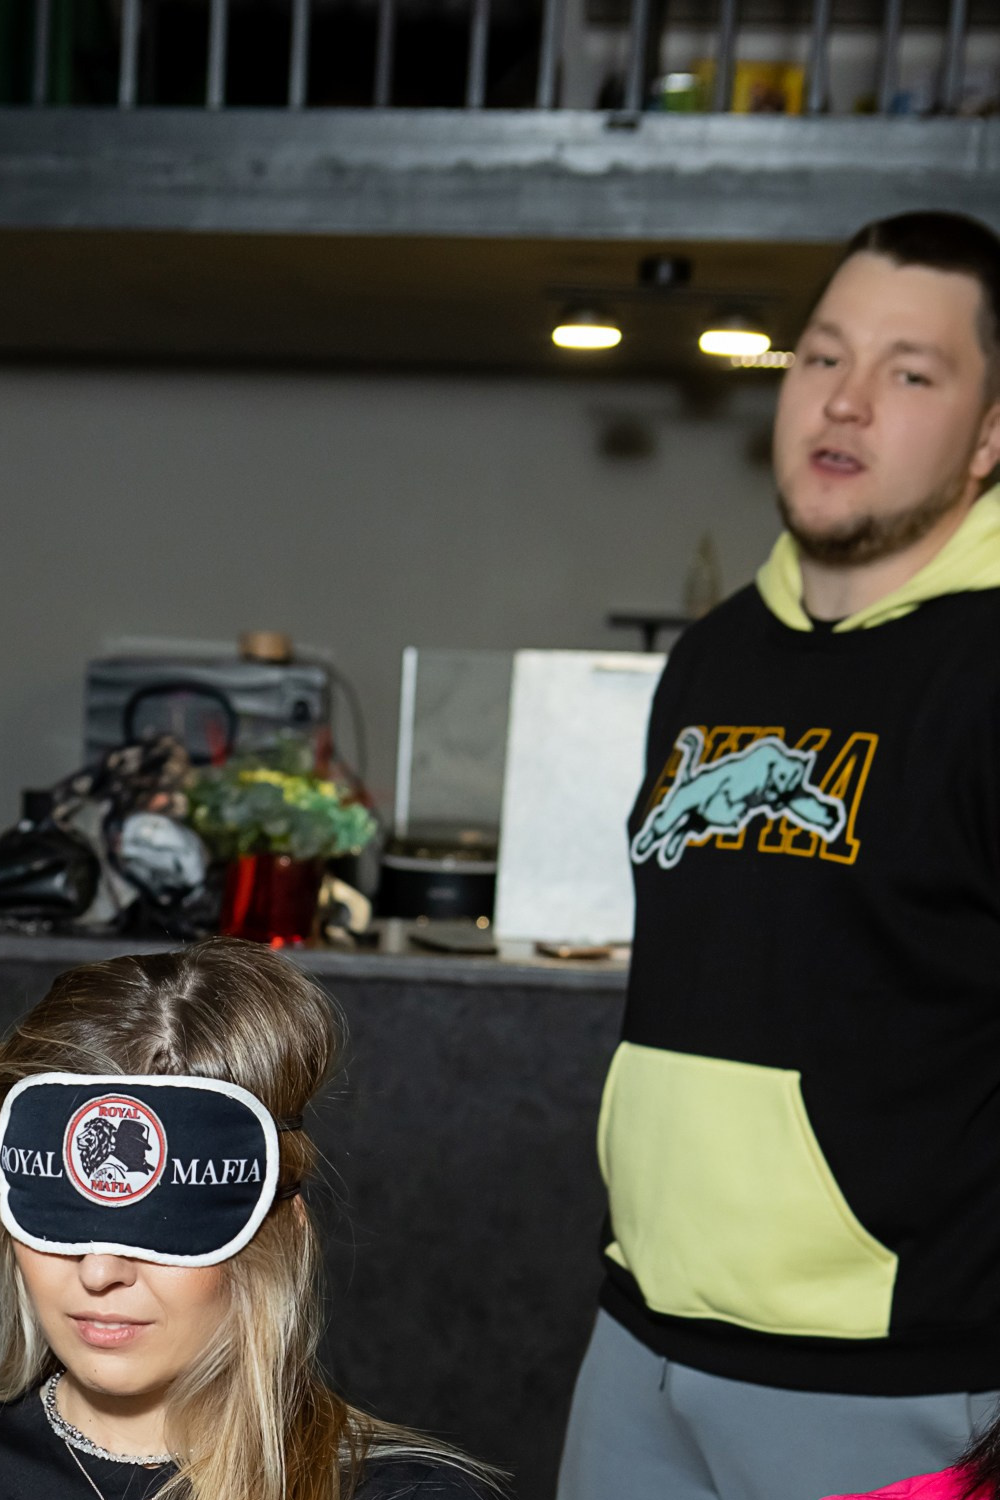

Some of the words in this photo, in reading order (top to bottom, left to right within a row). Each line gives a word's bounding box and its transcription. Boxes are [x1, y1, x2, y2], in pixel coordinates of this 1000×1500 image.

[98, 1105, 141, 1120] ROYAL
[1, 1145, 63, 1178] ROYAL
[171, 1158, 261, 1185] MAFIA
[90, 1179, 133, 1194] MAFIA
